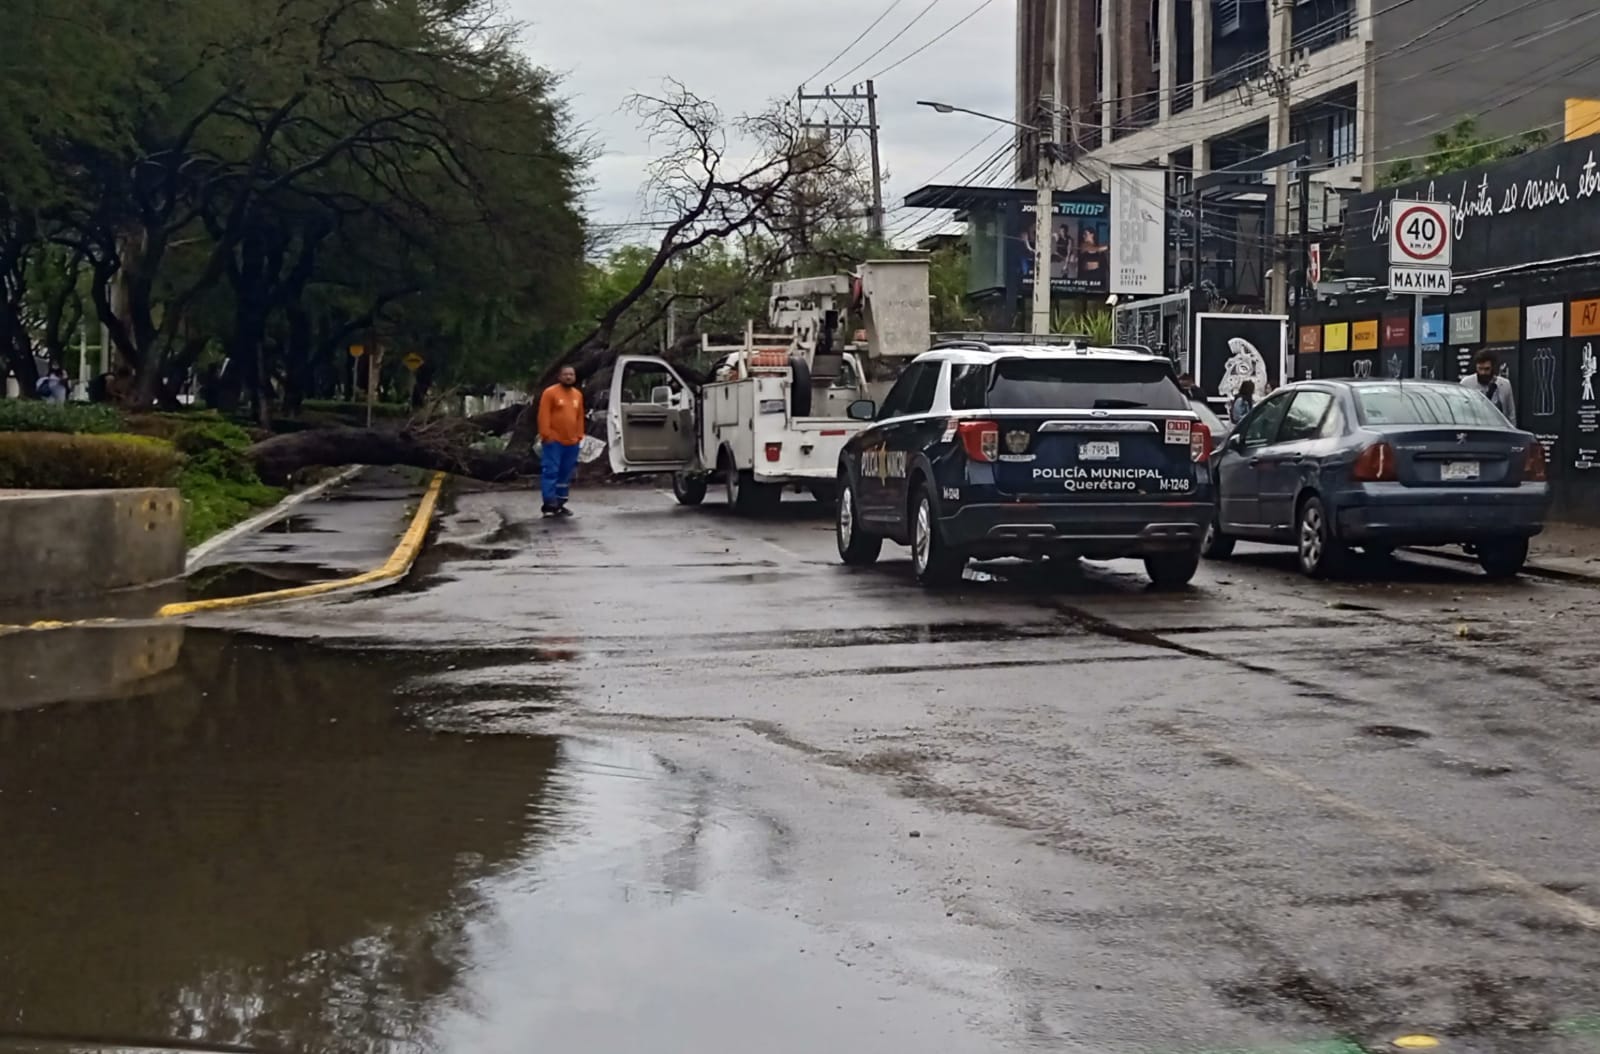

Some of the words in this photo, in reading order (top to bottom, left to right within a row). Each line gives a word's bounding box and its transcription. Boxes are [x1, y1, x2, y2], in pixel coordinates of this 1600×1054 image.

[1060, 203, 1105, 216] TROOP
[1406, 218, 1436, 240] 40
[1394, 272, 1446, 288] MAXIMA
[1168, 421, 1189, 430] 911
[1032, 466, 1087, 478] POLICÍA
[1091, 468, 1162, 479] MUNICIPAL
[1064, 479, 1136, 491] Querétaro
[1160, 479, 1189, 490] M-1248
